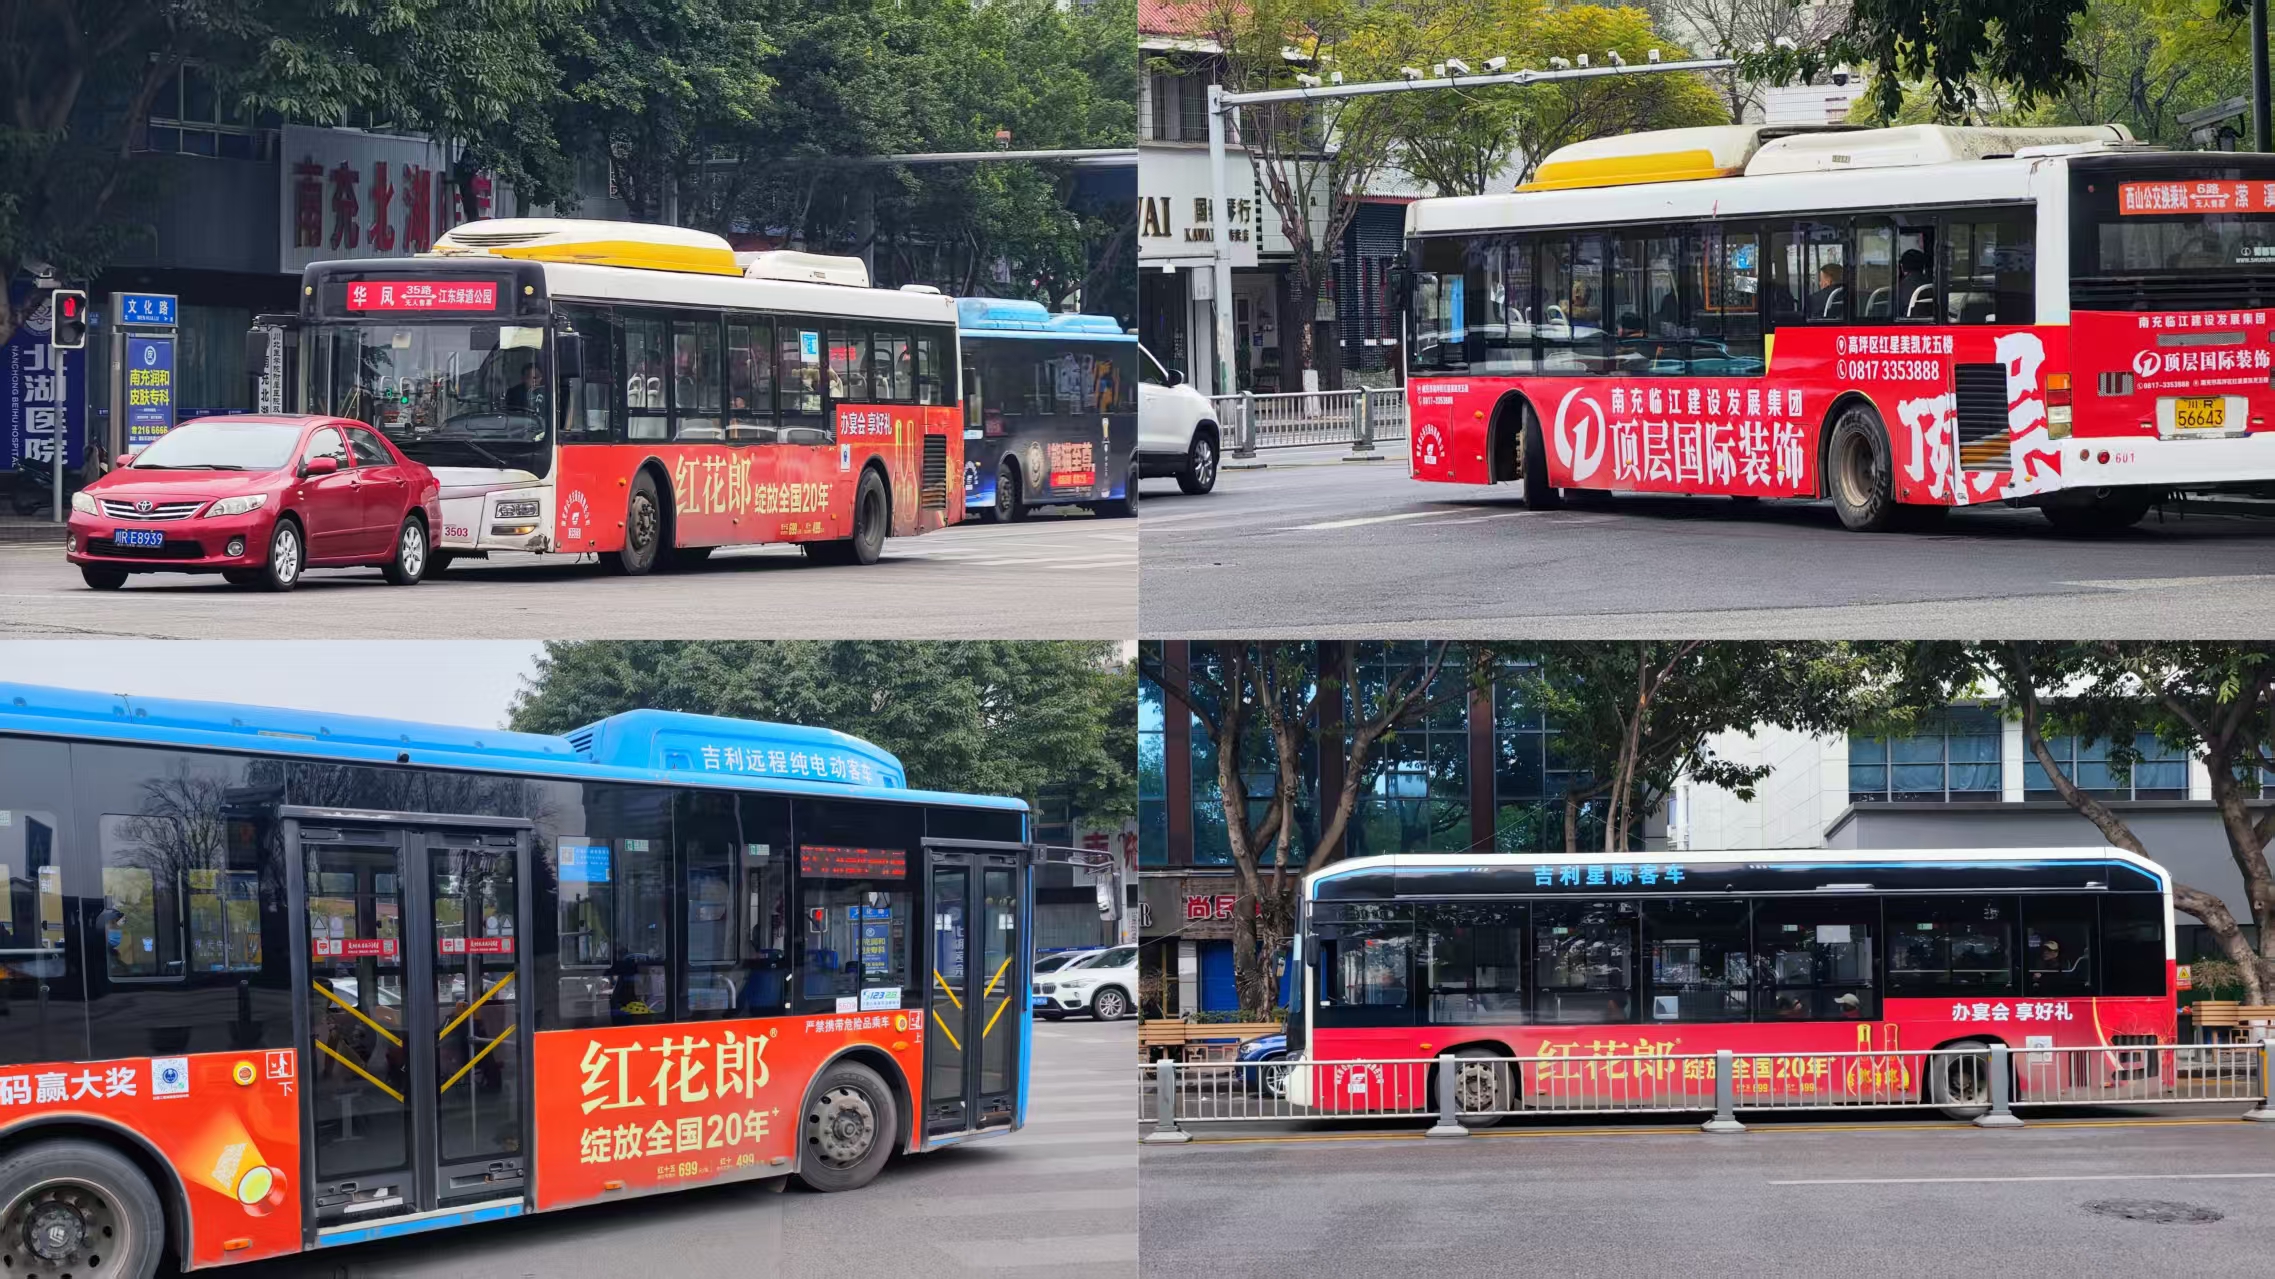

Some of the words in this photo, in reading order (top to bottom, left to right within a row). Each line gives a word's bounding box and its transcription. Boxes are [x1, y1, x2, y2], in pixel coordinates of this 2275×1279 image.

[2196, 183, 2220, 194] 6路
[406, 286, 432, 295] 35路
[438, 288, 492, 304] 江东绿道公园
[128, 299, 168, 315] 文化路
[2138, 312, 2266, 329] 南充临江建设发展集团
[1848, 335, 1954, 354] 高坪区红星美凯龙五楼
[2164, 349, 2271, 372] 顶层国际装饰
[130, 369, 170, 386] 南充润和
[1848, 361, 1878, 380] 0817
[1882, 361, 1940, 380] 3353888
[23, 343, 68, 465] 北湖医院
[130, 389, 170, 406] 皮肤专科
[1611, 387, 1803, 417] 南充临江建设发展集团
[840, 411, 866, 436] 办宴会
[867, 411, 892, 436] 享好礼
[2178, 409, 2223, 427] 56643
[1609, 418, 1805, 489] 顶层国际装饰
[444, 526, 468, 537] 3503
[700, 744, 873, 785] 吉利远程纯电动客车
[1533, 863, 1686, 887] 吉利星际客车
[1951, 1002, 2011, 1022] 办宴会
[2014, 1001, 2074, 1022] 享好礼
[805, 1015, 890, 1033] 严禁携带危险品乘车
[914, 1032, 922, 1044] 上
[0, 1066, 138, 1106] 码赢大奖
[277, 1081, 294, 1097] 下
[678, 1161, 698, 1177] 699
[736, 1153, 755, 1168] 499
